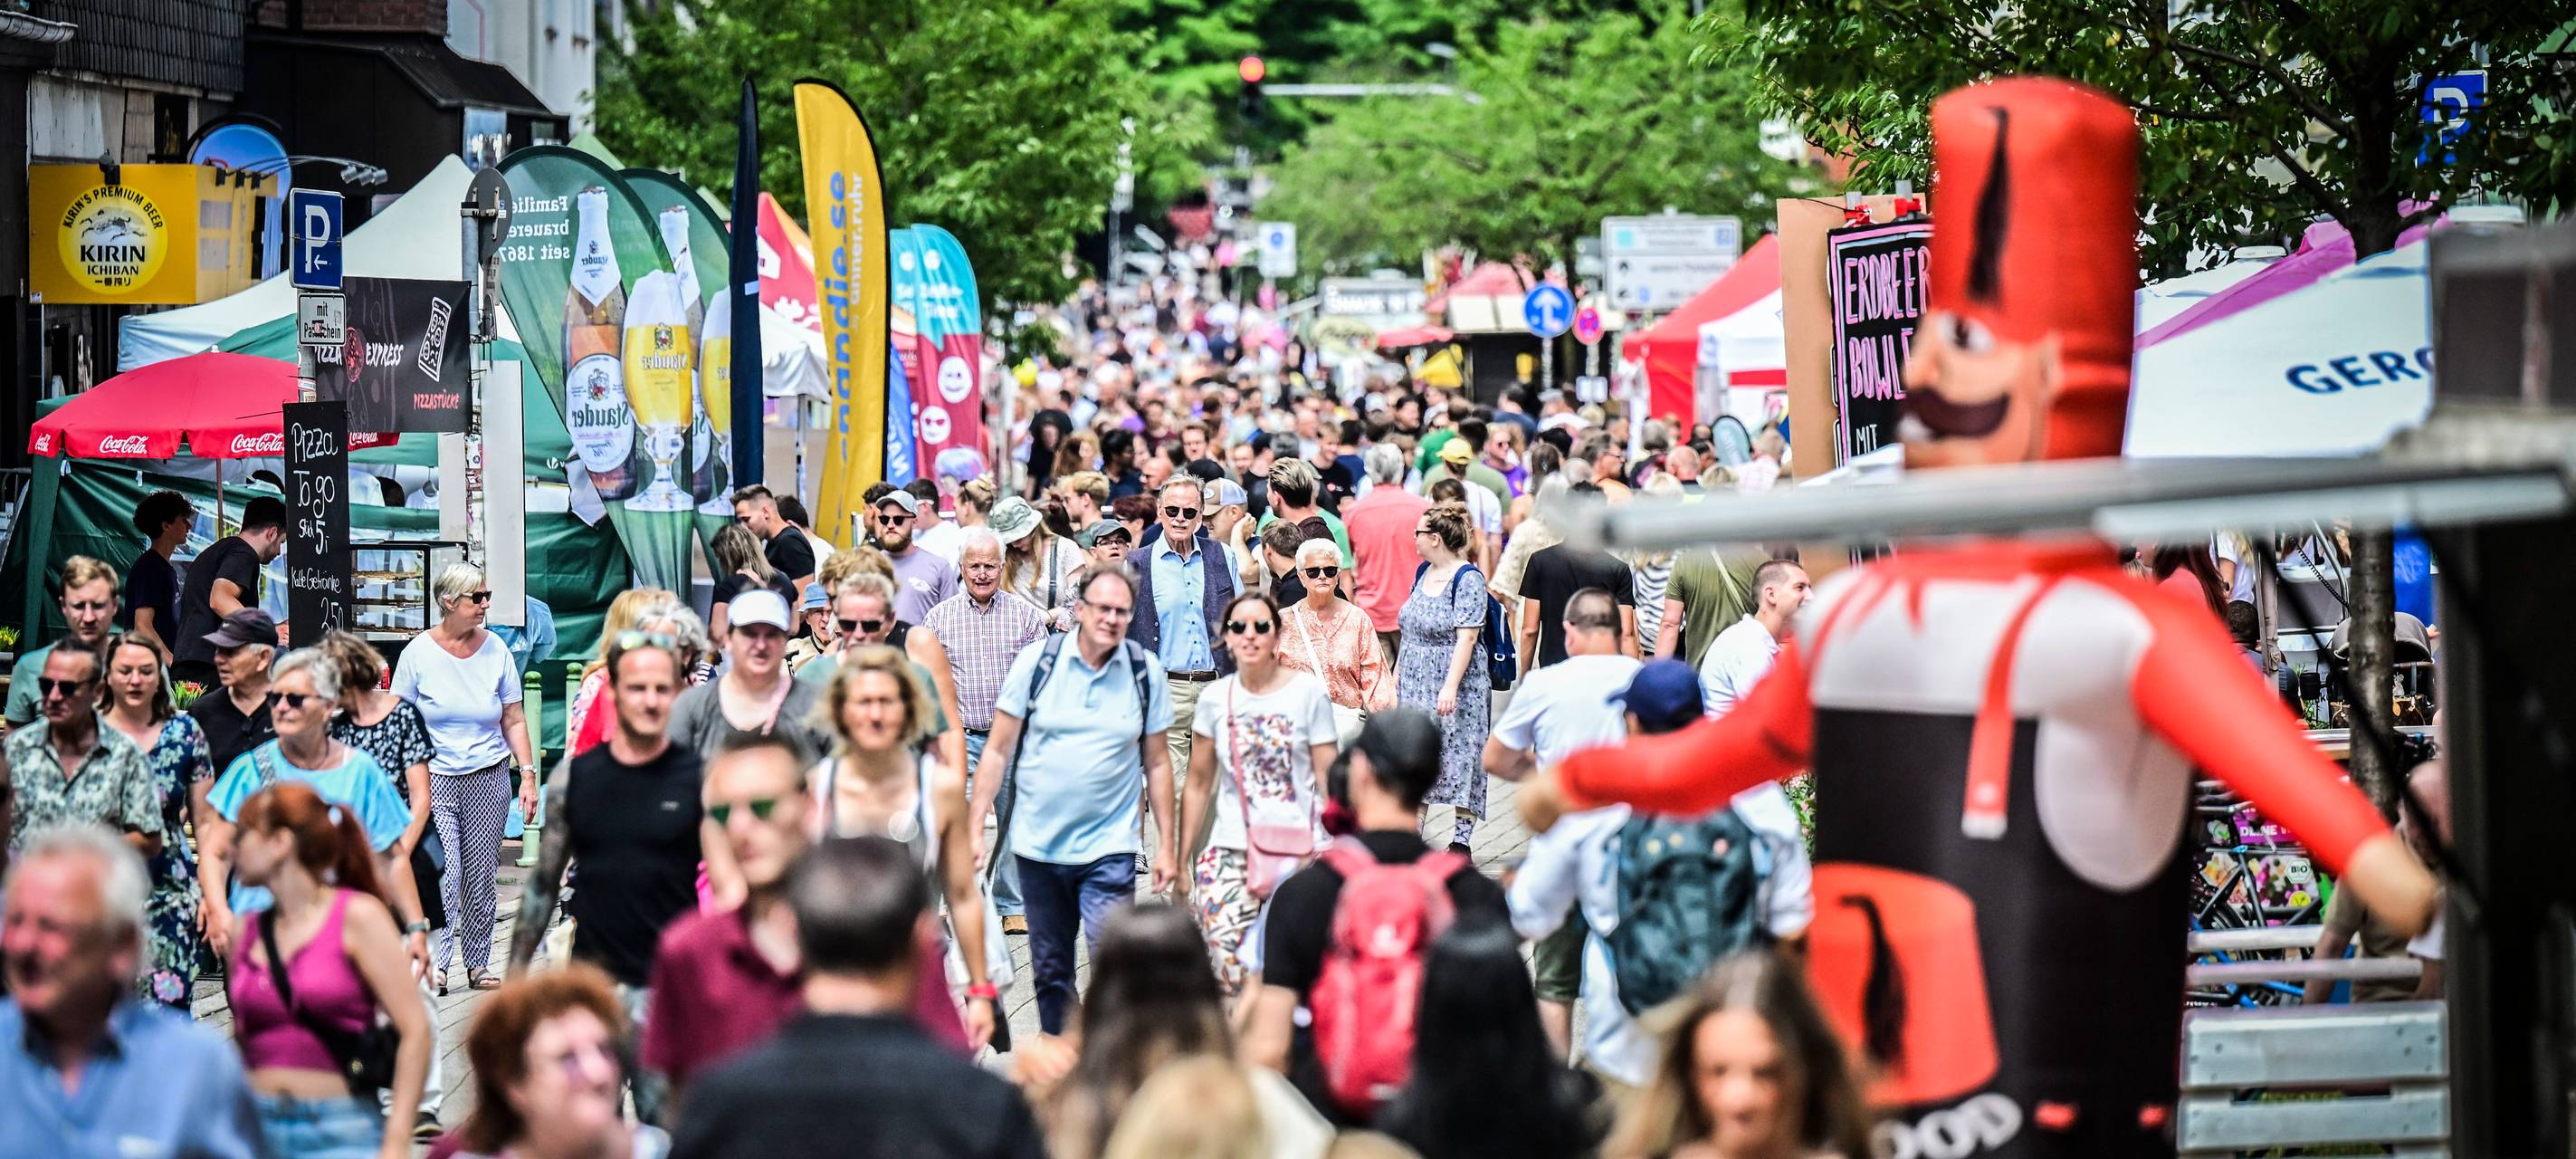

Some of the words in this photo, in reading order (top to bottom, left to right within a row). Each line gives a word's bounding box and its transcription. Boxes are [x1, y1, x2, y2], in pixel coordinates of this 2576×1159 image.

[2434, 87, 2469, 146] P
[62, 194, 92, 228] KIRIN'S
[92, 186, 145, 206] PREMIUM
[143, 202, 164, 229] BEER
[305, 205, 331, 273] P
[80, 244, 146, 263] KIRIN
[87, 264, 139, 275] ICHIBAN
[1844, 245, 1932, 325] ERDBEER
[316, 302, 328, 317] mit
[304, 322, 341, 339] Pachein
[314, 346, 343, 366] IZZA
[366, 342, 405, 368] EXPRESS
[414, 389, 461, 409] PIZZASTÜCKE
[100, 435, 149, 455] Coca-Cola
[231, 433, 284, 453] Coca-Cola
[291, 422, 339, 464] Pizza
[1856, 424, 1878, 455] MIT
[293, 470, 310, 507] To
[313, 475, 335, 519] go
